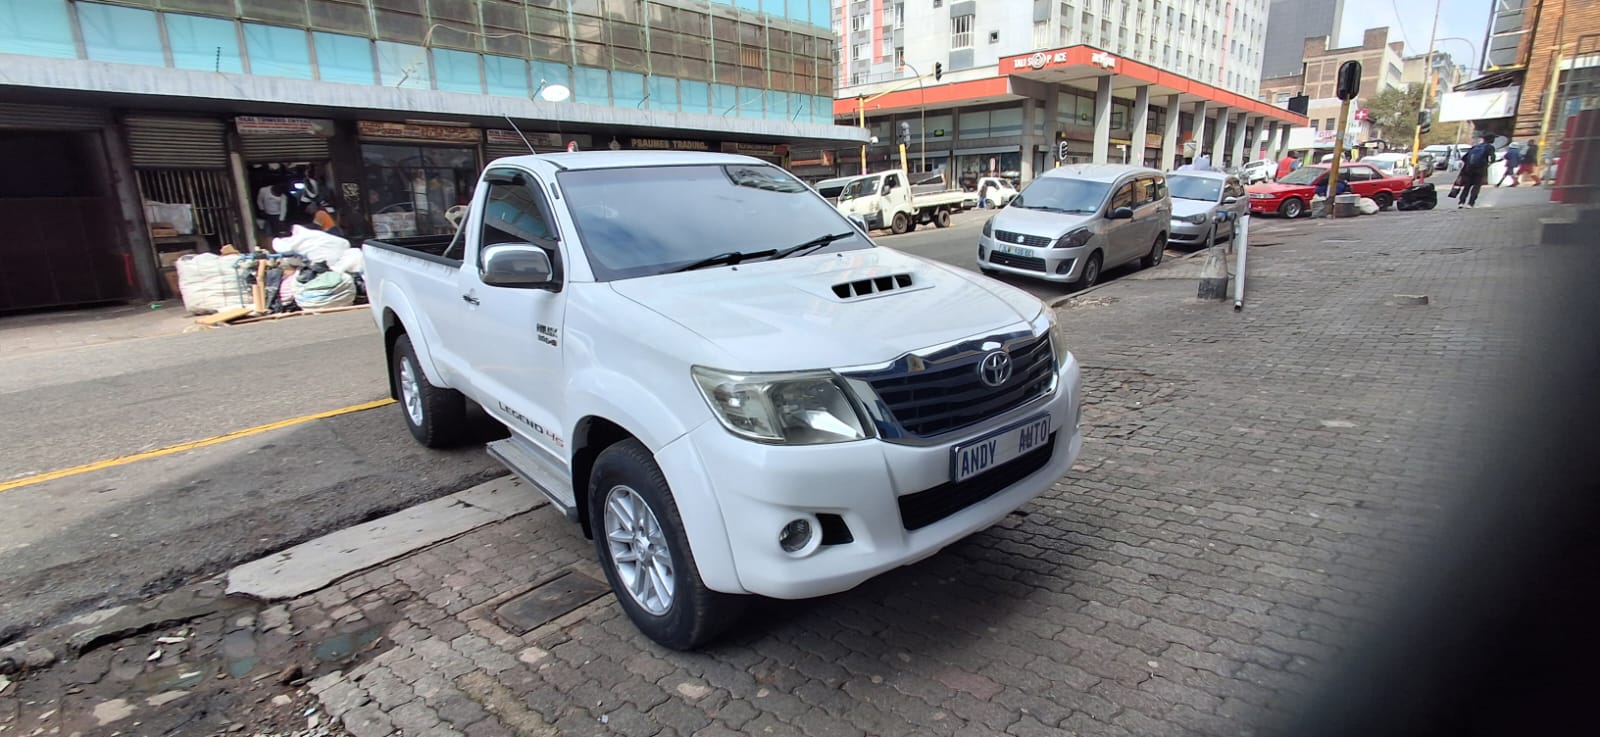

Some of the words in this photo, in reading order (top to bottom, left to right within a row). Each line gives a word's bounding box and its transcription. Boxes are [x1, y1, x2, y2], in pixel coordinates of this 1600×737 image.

[672, 140, 704, 149] TRADING
[498, 400, 544, 434] LEGEND
[961, 439, 997, 477] ANDY
[1018, 419, 1047, 453] AUTO
